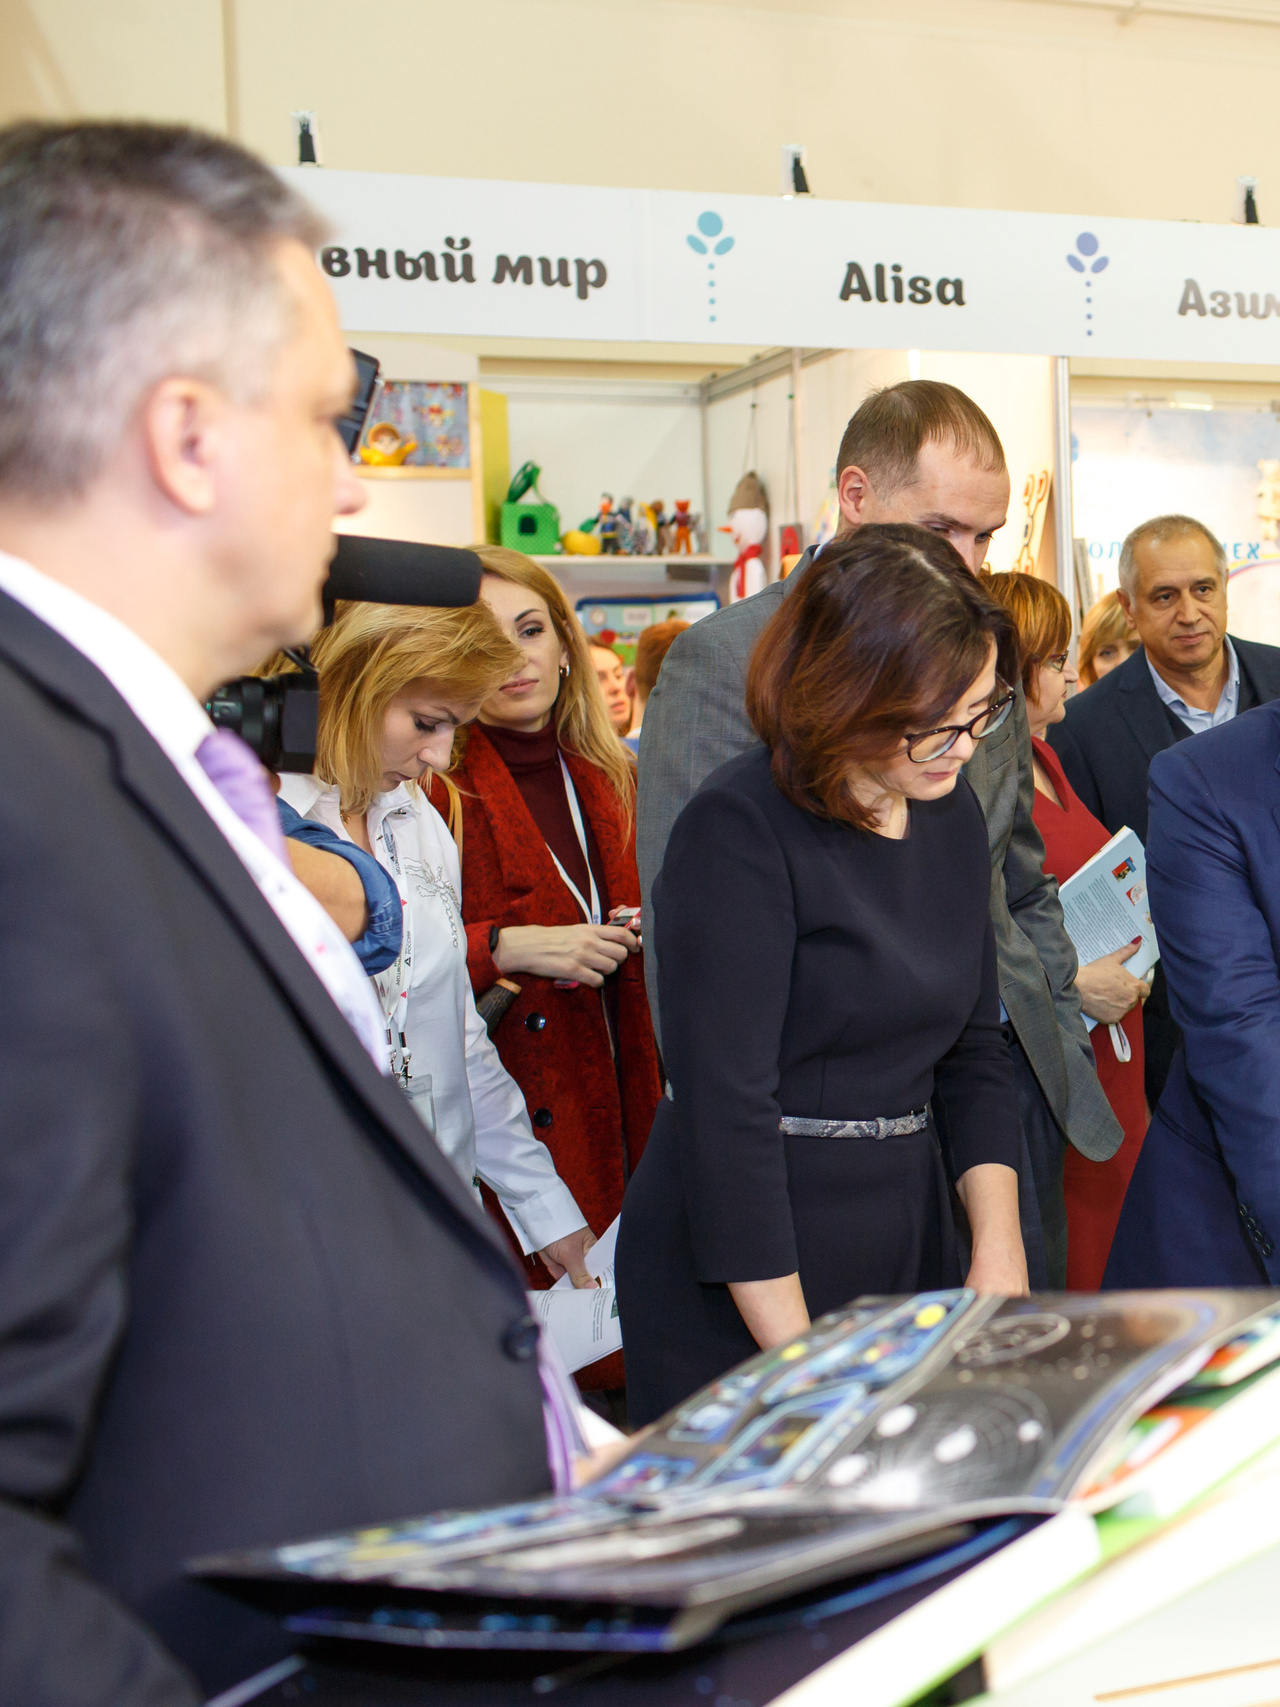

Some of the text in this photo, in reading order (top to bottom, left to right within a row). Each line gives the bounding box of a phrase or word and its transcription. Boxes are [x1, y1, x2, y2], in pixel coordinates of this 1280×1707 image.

[321, 236, 609, 300] вный мир
[839, 261, 967, 307] Alisa
